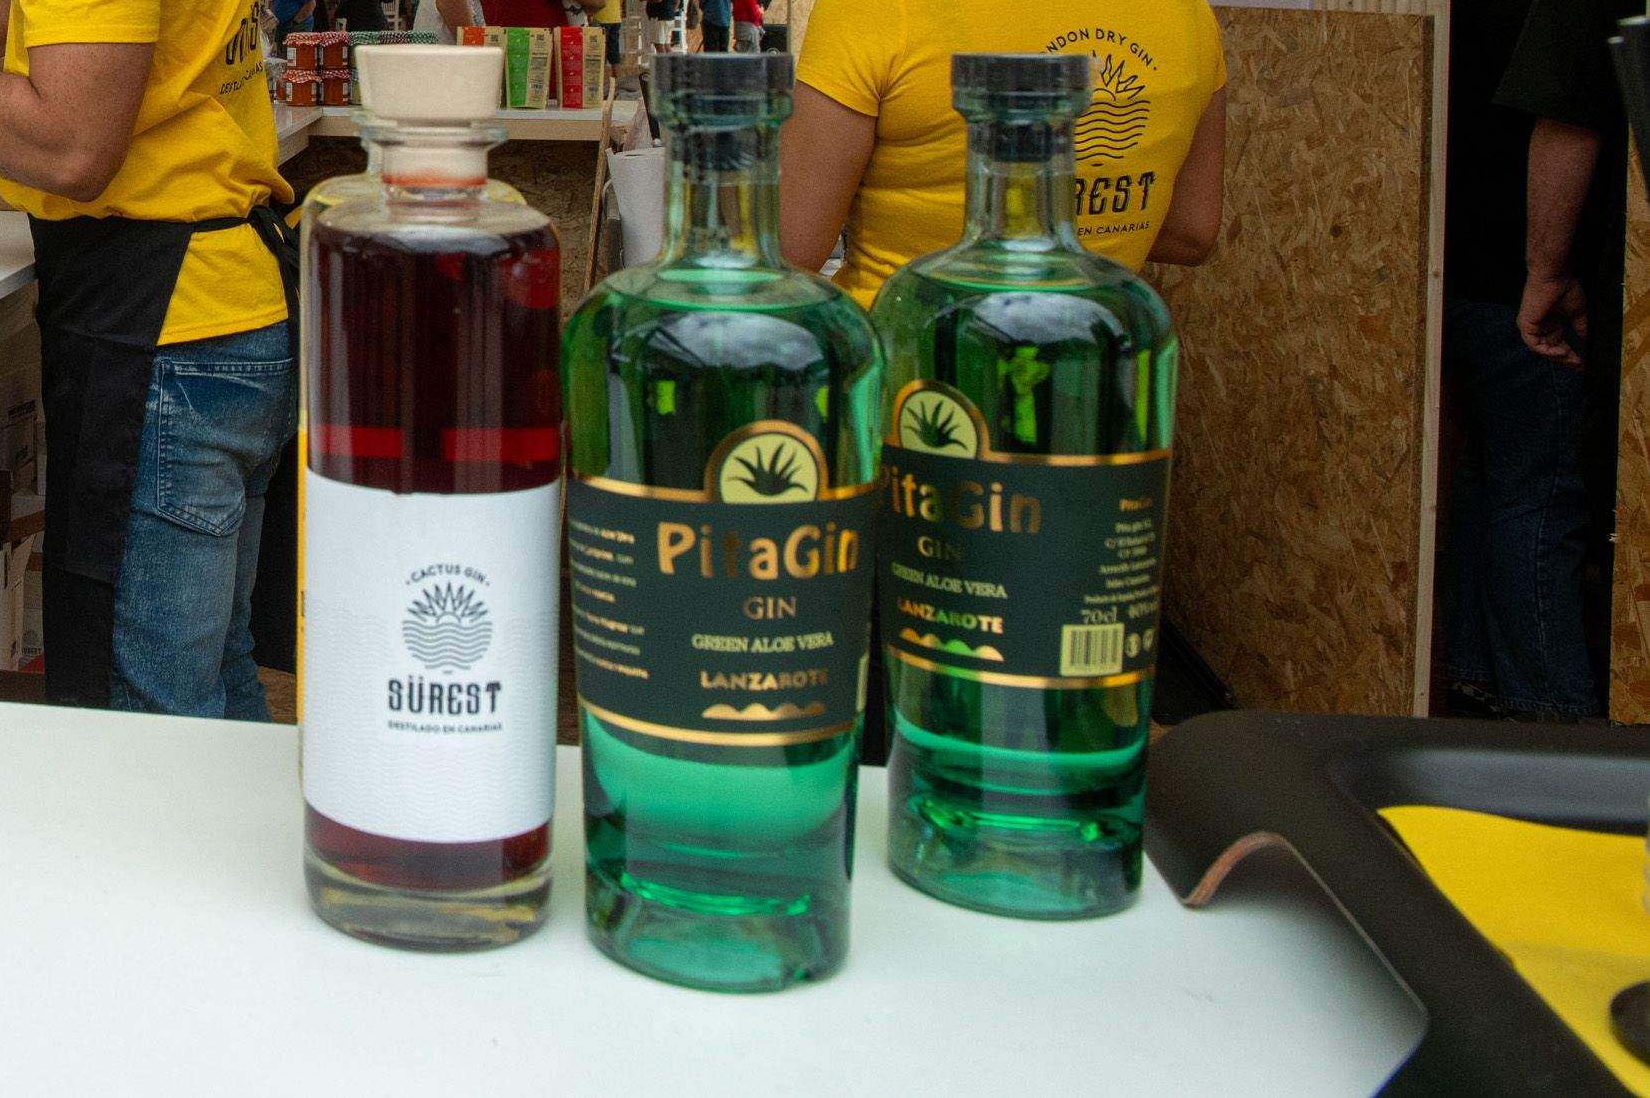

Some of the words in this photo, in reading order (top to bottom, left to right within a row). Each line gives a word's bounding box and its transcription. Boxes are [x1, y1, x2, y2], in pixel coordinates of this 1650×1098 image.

[1042, 28, 1090, 54] NDON
[1095, 28, 1127, 47] DRY
[1129, 42, 1154, 68] GIN
[1096, 221, 1151, 236] CANARIAS
[410, 563, 461, 582] CACTUS
[464, 566, 487, 583] GIN
[925, 574, 962, 595] ALOE
[964, 580, 1009, 600] VERA
[742, 595, 797, 621] GIN
[900, 600, 1004, 635] LANZAROTE
[691, 633, 749, 653] GREEN
[751, 635, 796, 653] ALOE
[797, 630, 835, 650] VERA
[700, 665, 829, 692] LANZAROTE
[388, 674, 502, 715] SÜREST
[388, 720, 440, 733] DESTILADO
